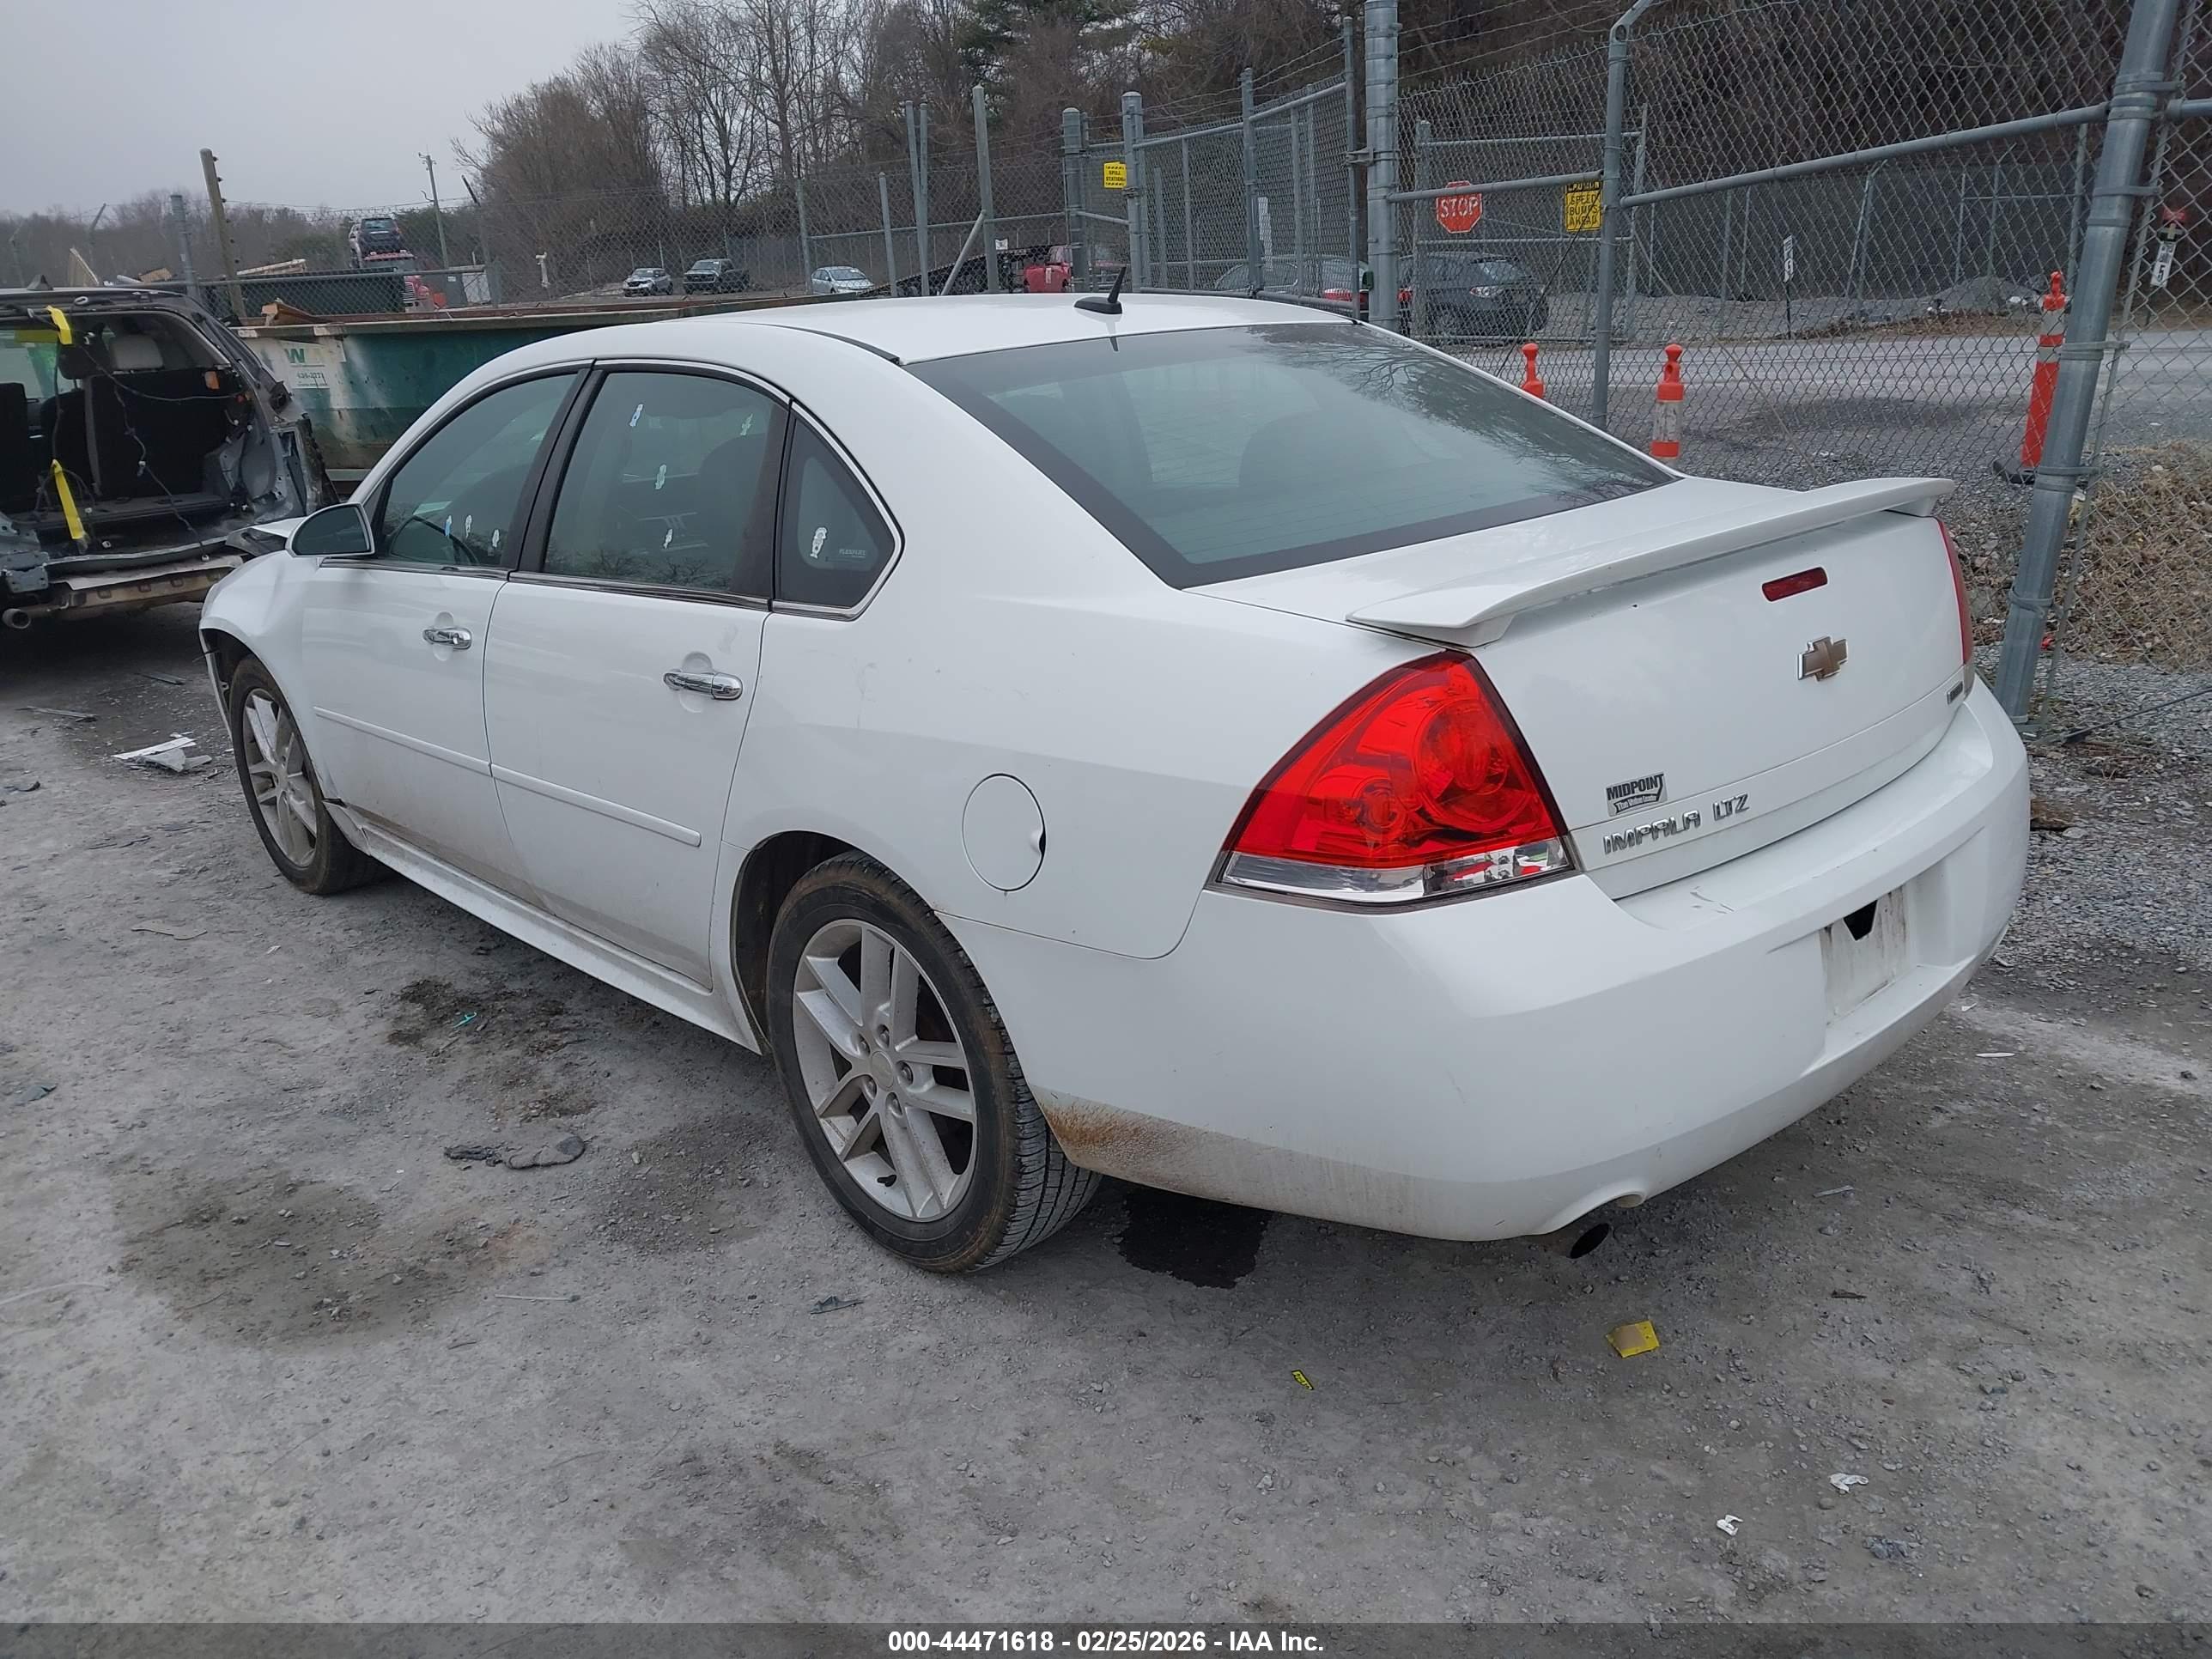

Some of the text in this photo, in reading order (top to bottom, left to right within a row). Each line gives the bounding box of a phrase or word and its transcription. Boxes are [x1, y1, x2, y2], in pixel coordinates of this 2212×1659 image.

[1441, 197, 1479, 218] STOP
[1571, 194, 1597, 205] SPEED
[1570, 205, 1598, 216] BUMPS
[1570, 215, 1598, 226] AHEAD
[1606, 773, 1664, 801] MIDPOINT
[1603, 793, 1750, 854] IMPALA LTZ
